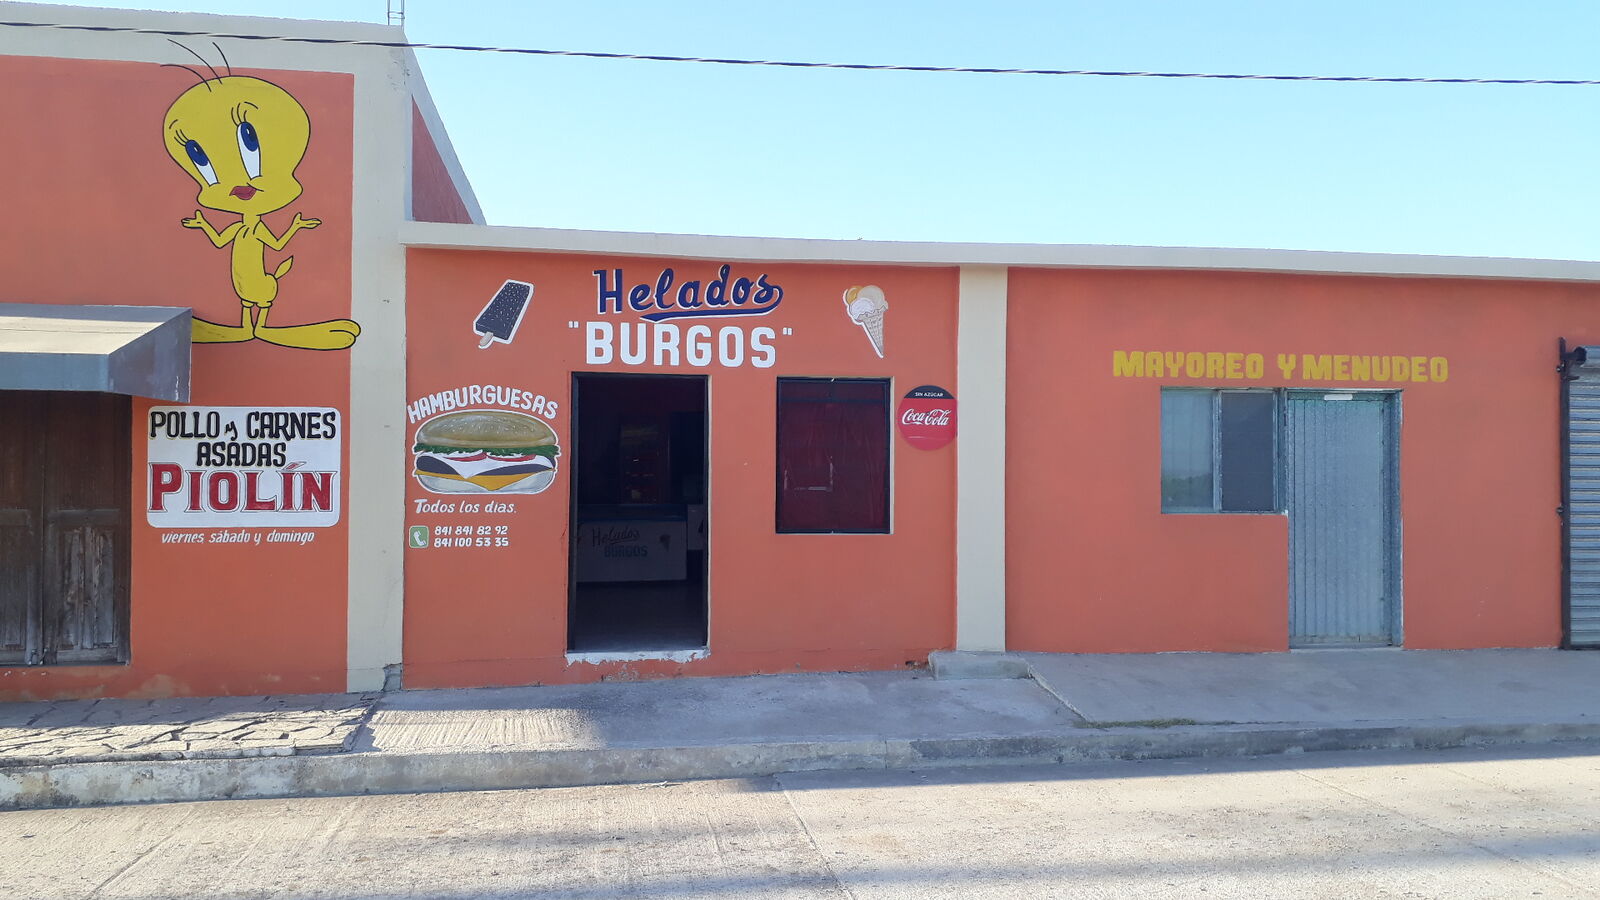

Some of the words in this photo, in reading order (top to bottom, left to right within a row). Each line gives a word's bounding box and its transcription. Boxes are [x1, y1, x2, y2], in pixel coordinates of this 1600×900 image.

[592, 264, 783, 323] Helados
[1113, 350, 1264, 380] MAYOREO
[1277, 354, 1296, 380] Y
[1302, 354, 1449, 383] MENUDEO
[407, 384, 559, 424] HAMBURGUESAS
[150, 411, 220, 438] POLLO
[225, 420, 238, 441] y
[246, 411, 336, 441] CARNES
[196, 441, 287, 467] ASADAS
[148, 461, 338, 513] PIOLÍN
[414, 498, 455, 514] Todos
[459, 500, 480, 513] los
[208, 529, 251, 543] sábado
[254, 532, 261, 545] y
[266, 529, 315, 546] domingo
[434, 525, 452, 536] 841
[455, 525, 473, 536] 841
[476, 525, 491, 536] 82
[495, 525, 509, 536] 92
[434, 537, 452, 548] 841
[455, 537, 472, 548] 100
[475, 537, 491, 548] 53
[495, 537, 509, 548] 35
